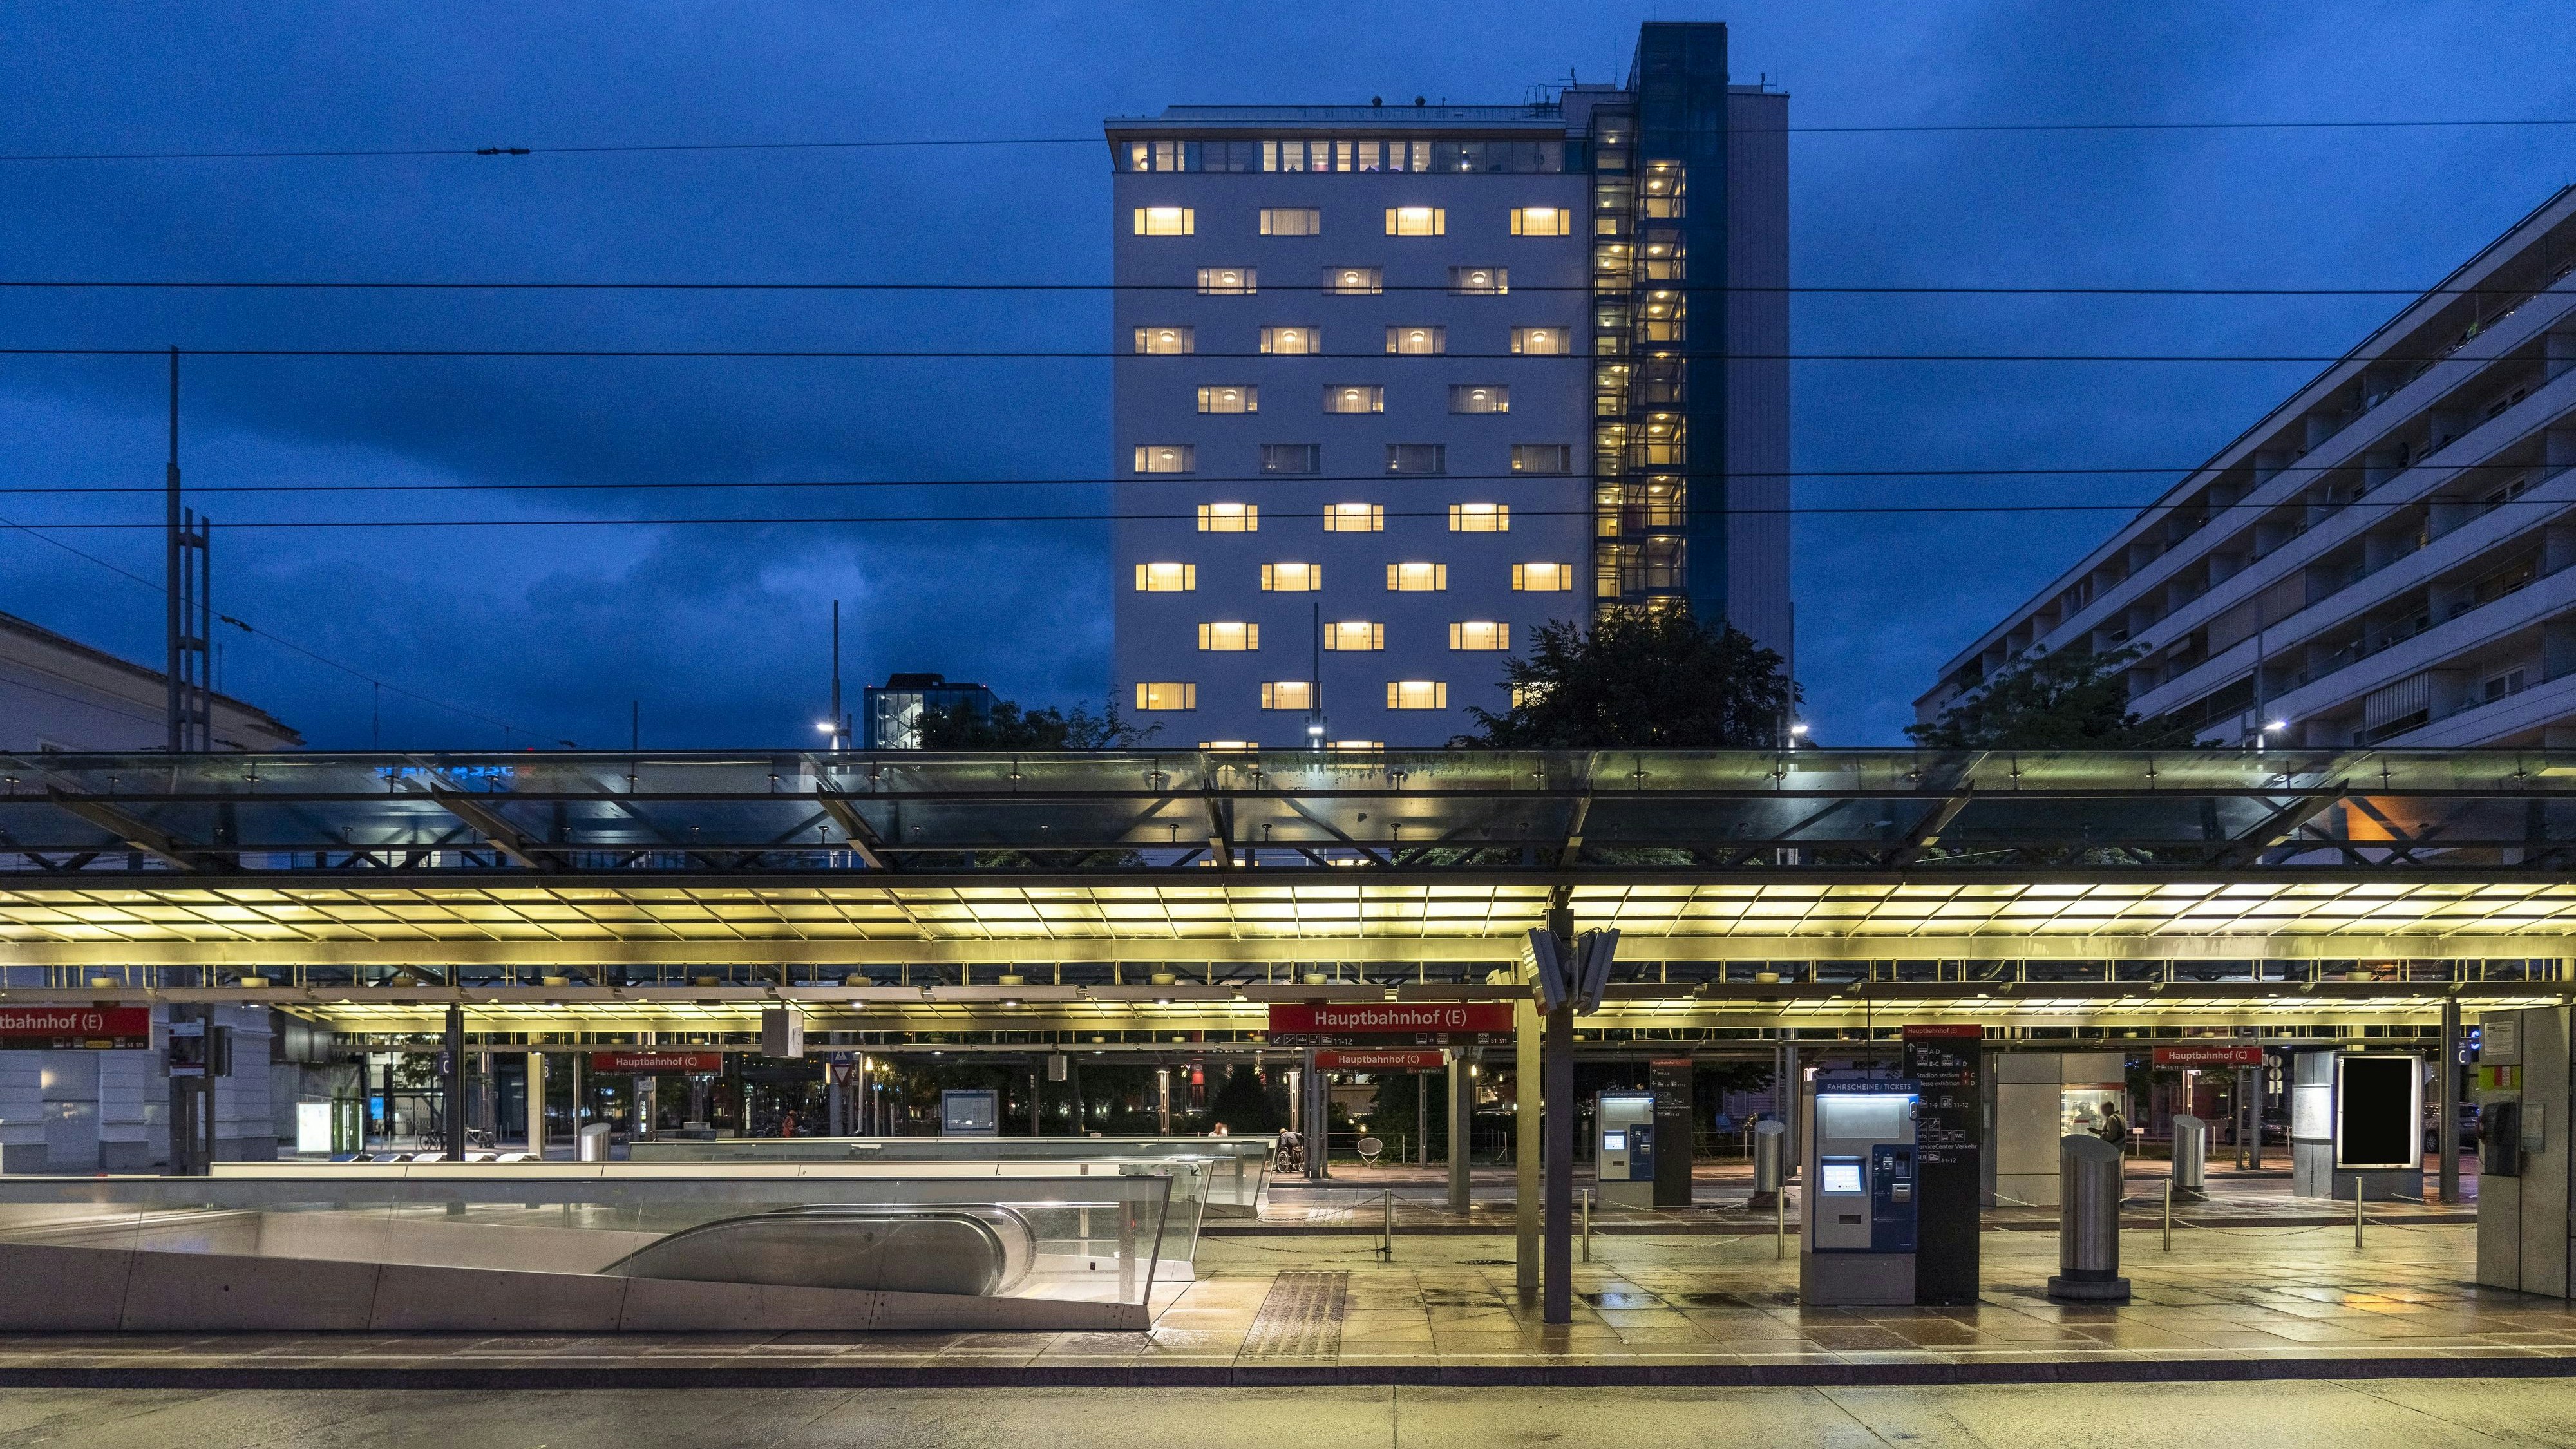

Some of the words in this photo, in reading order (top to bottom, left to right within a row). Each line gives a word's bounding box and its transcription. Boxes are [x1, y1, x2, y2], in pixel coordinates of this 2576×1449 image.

[82, 1013, 103, 1030] (E)
[1315, 1009, 1440, 1028] Hauptbahnhof
[1446, 1009, 1466, 1026] (E)
[616, 1057, 683, 1067] Hauptbahnhof
[685, 1057, 697, 1066] (C)
[1338, 1056, 1405, 1065] Hauptbahnhof
[1407, 1055, 1419, 1065] (C)
[2168, 1051, 2233, 1061] Hauptbahnhof
[2235, 1051, 2248, 1060] (C)
[2459, 1050, 2465, 1063] C
[443, 1060, 449, 1074] C
